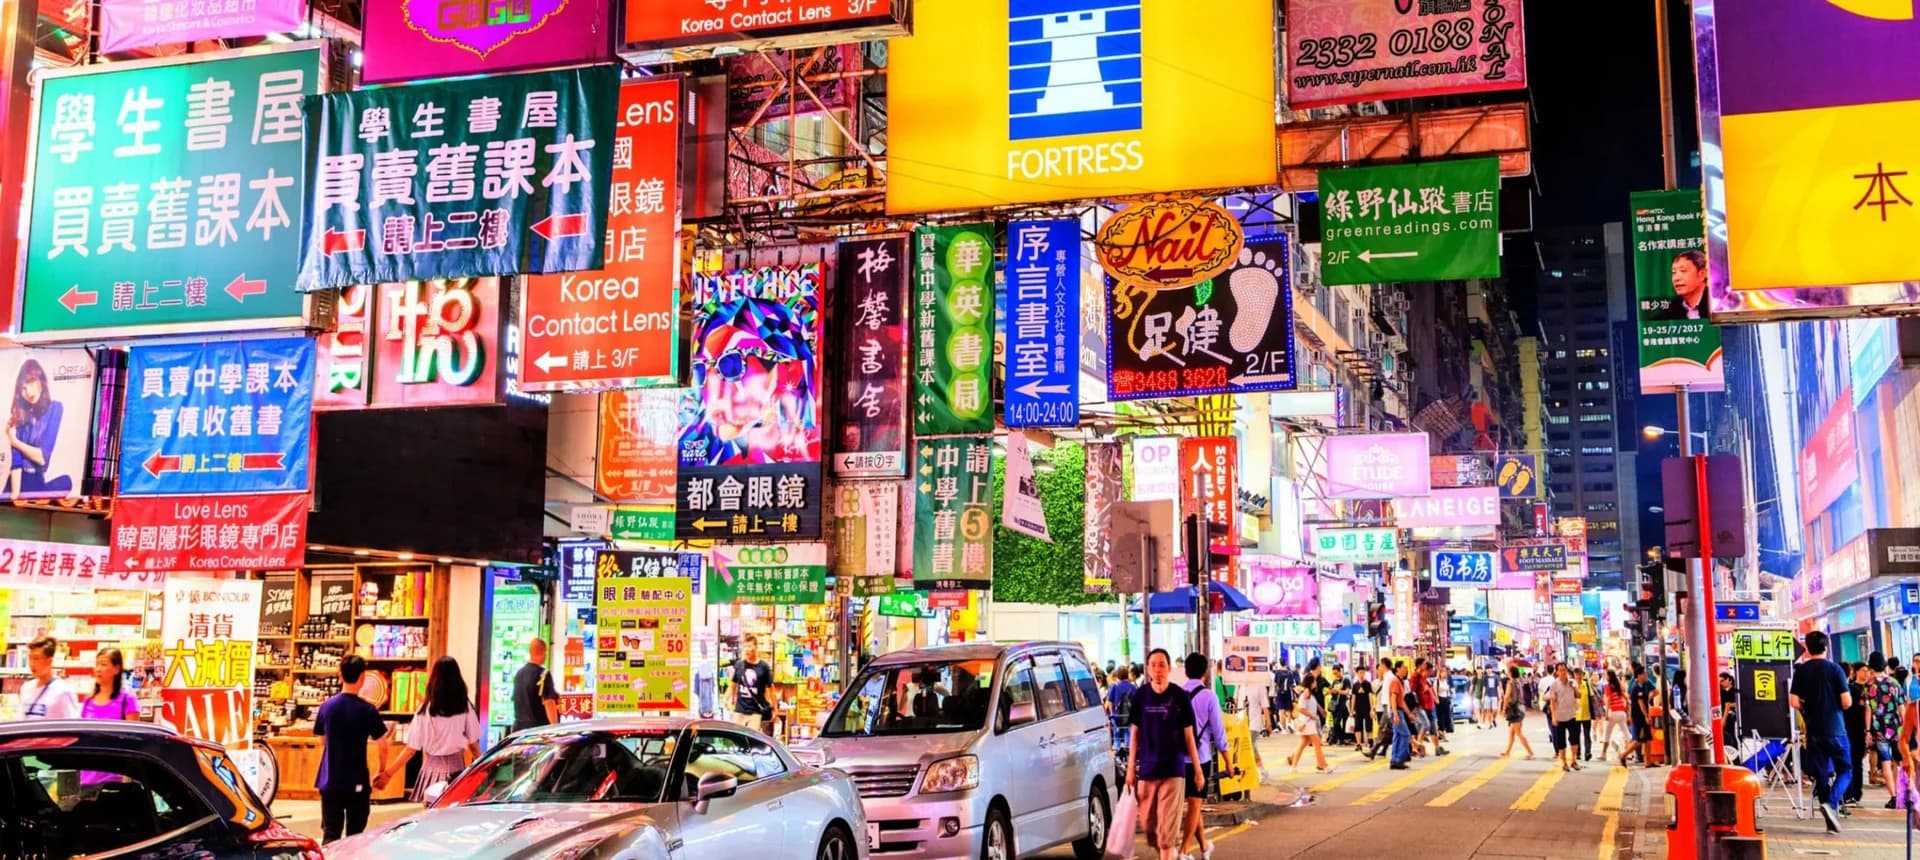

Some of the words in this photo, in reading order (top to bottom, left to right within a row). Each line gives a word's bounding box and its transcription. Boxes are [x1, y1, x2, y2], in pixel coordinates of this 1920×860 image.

[681, 15, 723, 34] Korea
[730, 9, 792, 29] Contact
[799, 3, 831, 21] Lens
[1297, 32, 1378, 69] 2332
[1389, 18, 1474, 56] 0188
[1295, 54, 1477, 88] www.supernail.com.hk
[48, 69, 304, 164] 學生書屋
[358, 91, 558, 143] 學生書屋
[616, 99, 675, 128] ens
[320, 134, 595, 212] 買賣舊課本
[1007, 140, 1144, 180] FORTRESS
[1854, 162, 1914, 222] 本
[48, 168, 294, 260] 買賣舊課本
[1326, 218, 1493, 241] greenreadings.com
[1637, 214, 1655, 225] Hong
[1657, 212, 1675, 222] Kong
[1677, 211, 1695, 221] Book
[383, 208, 510, 255] 請上二樓
[1106, 211, 1218, 268] Nail
[1327, 250, 1351, 265] 2/F
[112, 276, 208, 312] 請上二樓
[560, 276, 640, 302] Korea
[762, 268, 813, 299] HIDE
[918, 232, 936, 386] 買賣中學新舊課本
[1013, 225, 1051, 378] 序言書室
[528, 313, 617, 338] Contact
[623, 309, 671, 333] Lens
[853, 240, 896, 418] 梅馨書舍
[953, 239, 984, 413] 華英書局
[1643, 324, 1704, 336] 19-25/7/2017
[573, 349, 607, 371] 請上
[611, 347, 640, 369] 3/F
[1246, 351, 1286, 374] 2/F
[141, 361, 299, 398] 買賣中學課本
[152, 404, 283, 438] 高價收舊書
[1009, 402, 1074, 424] 14:00-24:00
[1214, 445, 1227, 496] MONEY
[687, 474, 806, 512] 都會眼鏡
[932, 443, 960, 574] 中學舊書
[1396, 496, 1496, 518] LANEIGE
[175, 502, 211, 520] Love
[214, 501, 248, 518] Lens
[731, 513, 799, 535] 請上一樓
[189, 556, 219, 569] Korea
[188, 612, 235, 638] 清貨
[666, 639, 684, 653] 50
[1735, 633, 1793, 657] 網上行
[164, 639, 253, 688] 大減價
[161, 690, 252, 751] SALE
